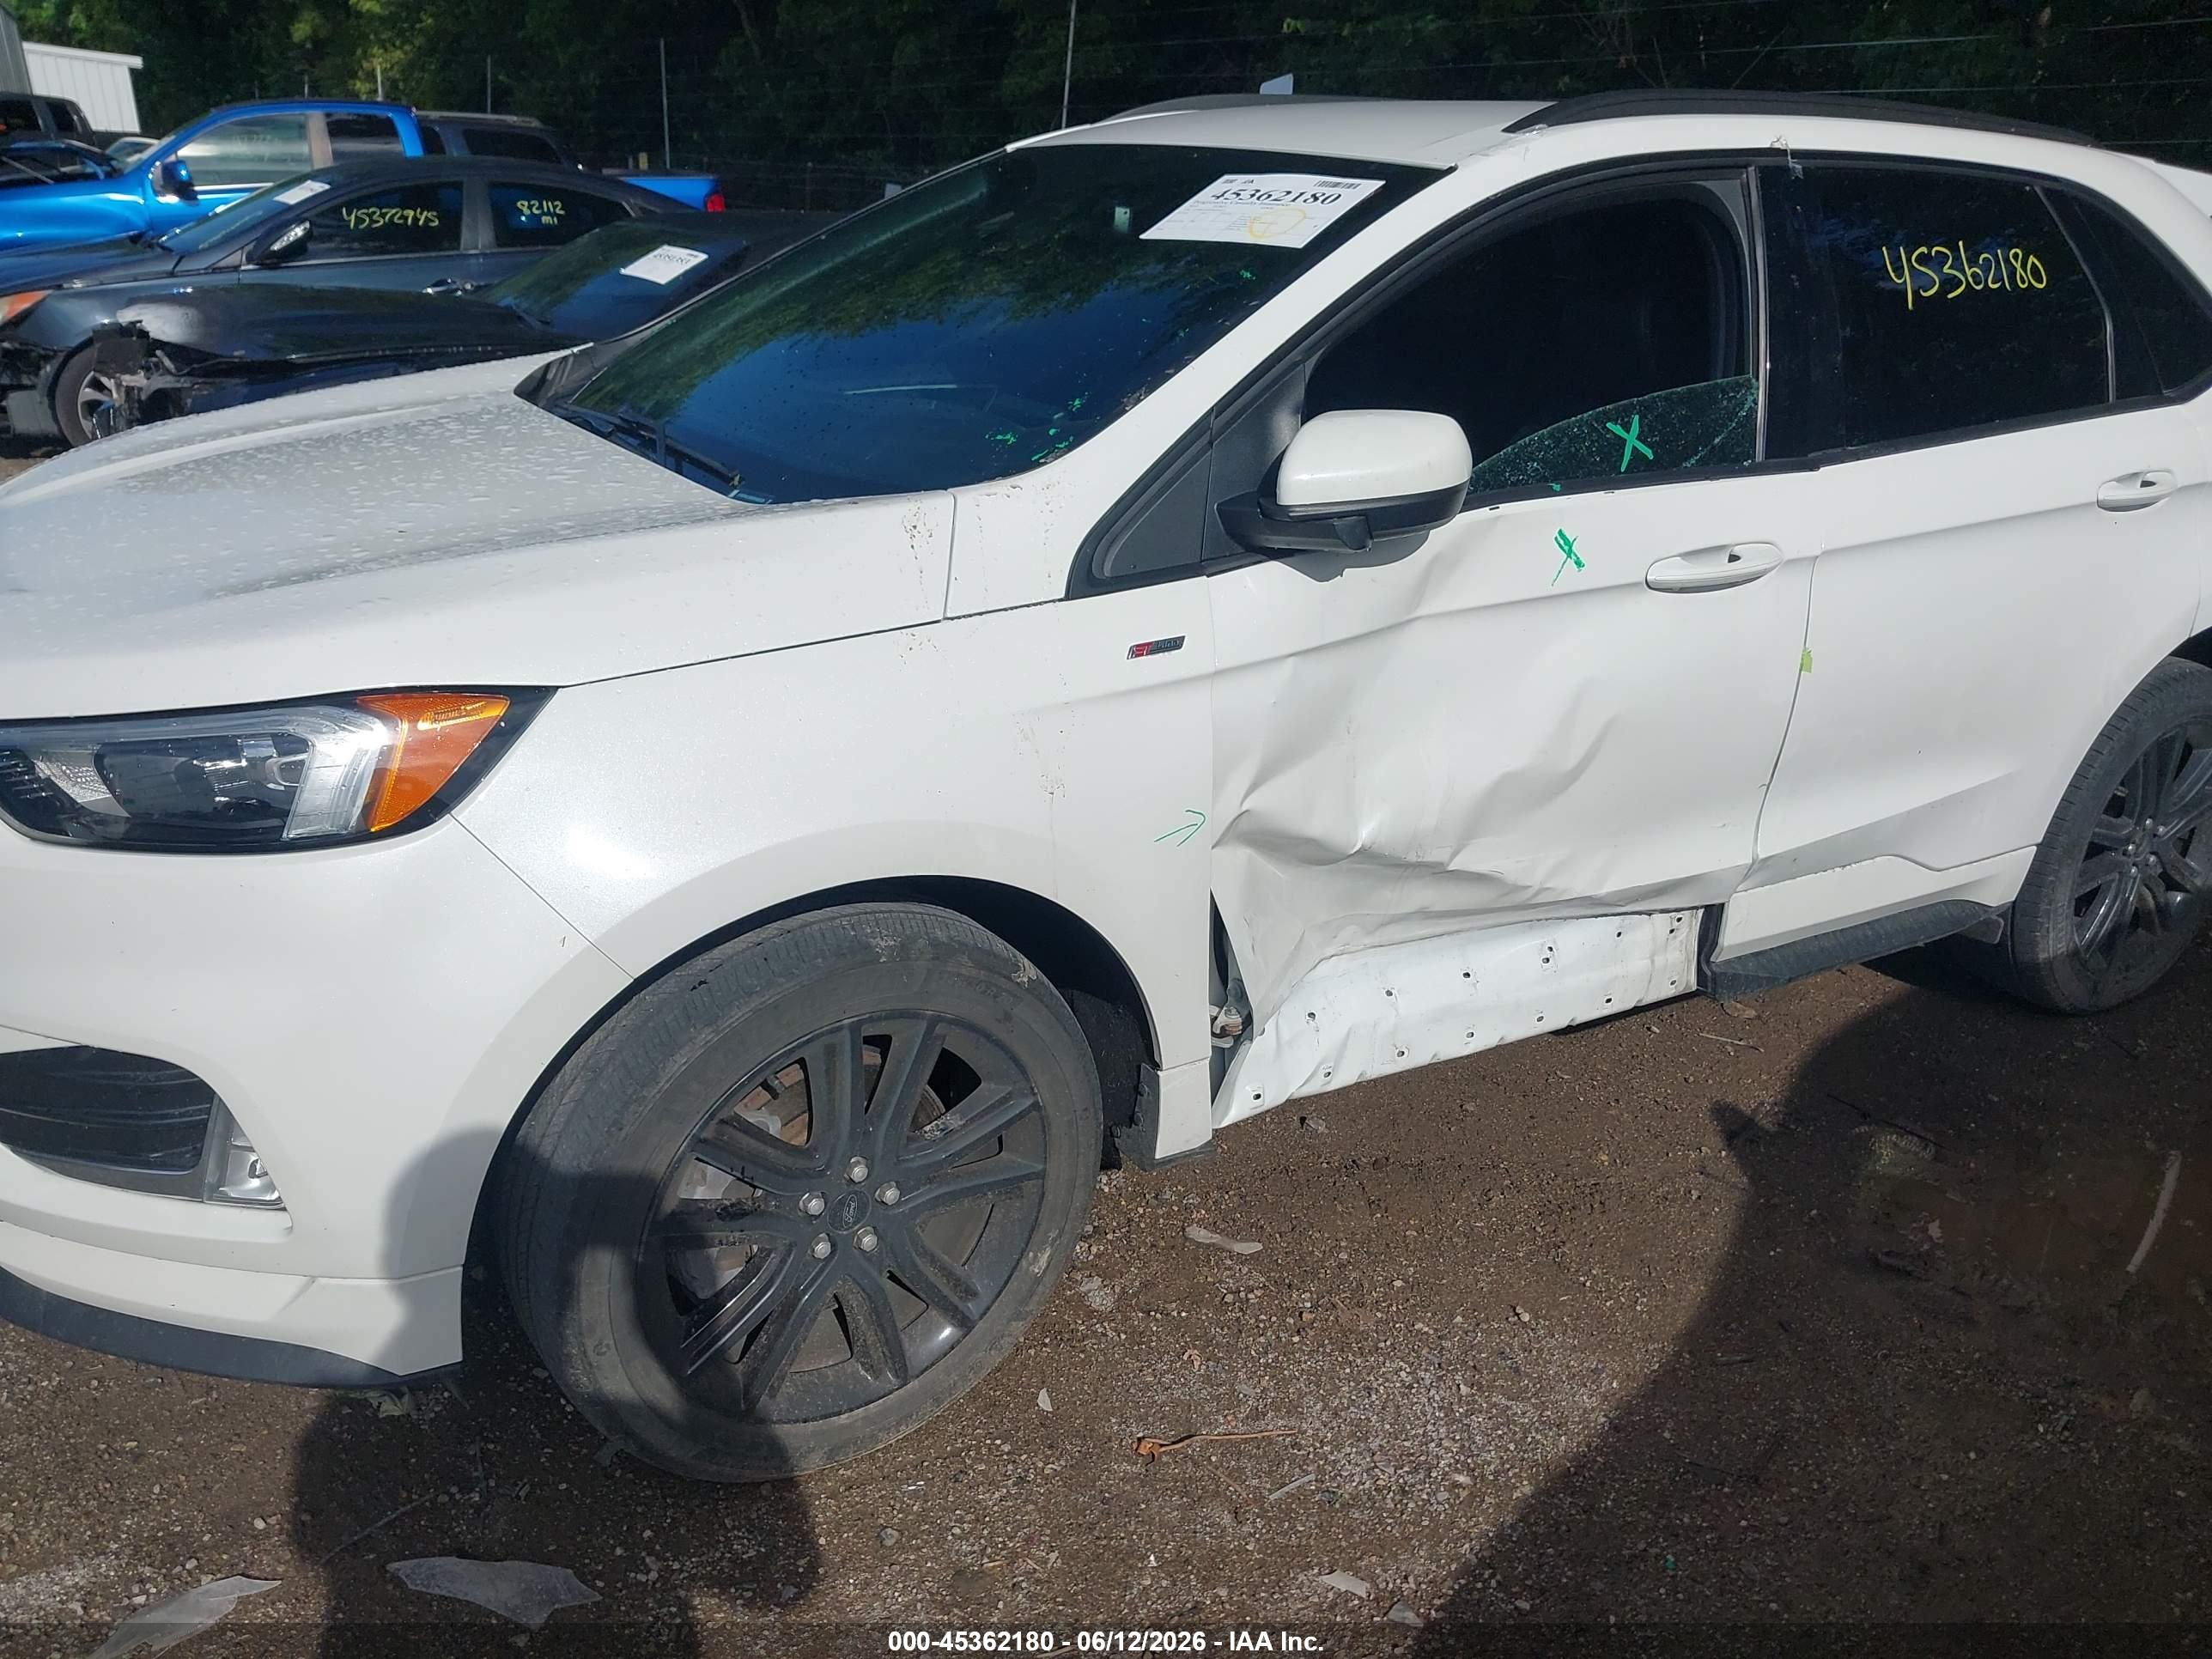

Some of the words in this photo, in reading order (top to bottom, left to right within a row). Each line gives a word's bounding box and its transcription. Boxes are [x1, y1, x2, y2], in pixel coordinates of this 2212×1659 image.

[516, 199, 566, 216] 82112
[1211, 188, 1342, 206] 45362180
[342, 206, 440, 230] 45372945
[1881, 240, 2048, 310] 45362180
[845, 1200, 856, 1223] Ford
